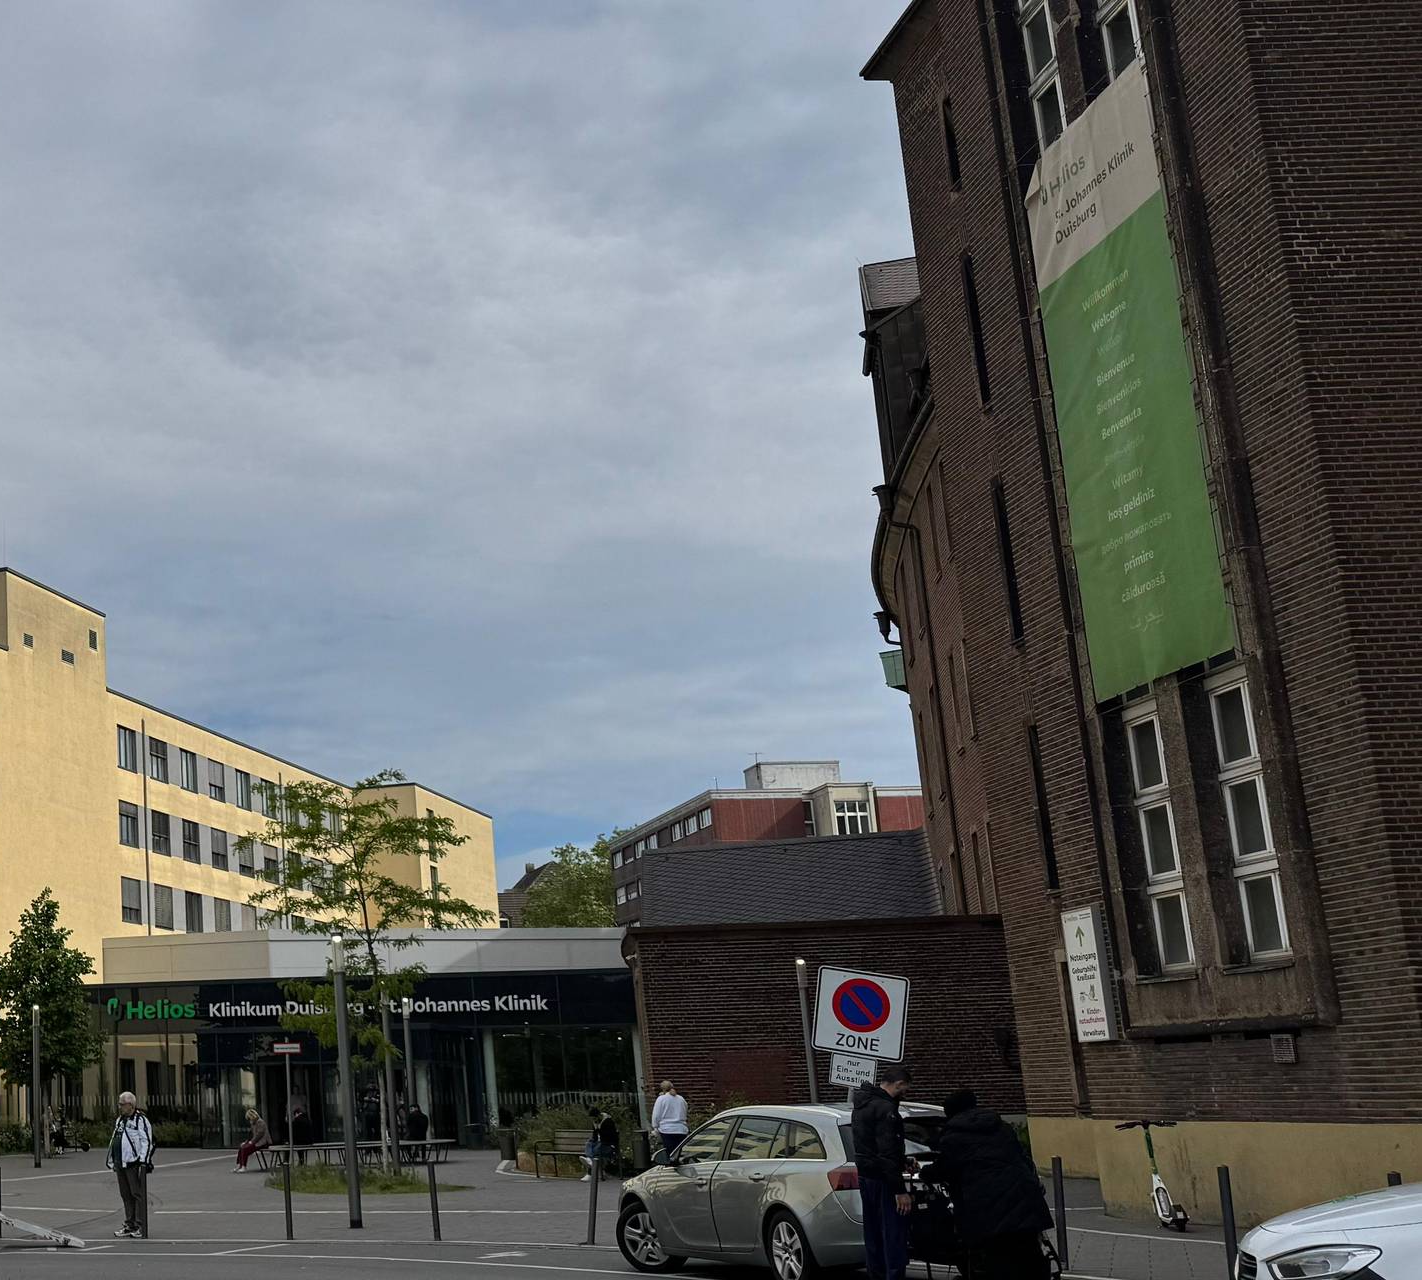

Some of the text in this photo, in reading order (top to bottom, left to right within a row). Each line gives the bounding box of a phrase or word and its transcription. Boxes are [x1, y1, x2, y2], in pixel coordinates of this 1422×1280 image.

[1049, 156, 1086, 198] Hlios
[1065, 168, 1107, 213] Johannes
[1107, 142, 1135, 174] Klinik
[1055, 203, 1097, 244] Duisburg
[1082, 269, 1128, 312] Willkommen
[1091, 301, 1127, 333] Welcome
[1096, 353, 1135, 386] Bienvenue
[1096, 377, 1142, 415] Bienvenidos
[1100, 407, 1142, 440] Benvenuta
[1111, 465, 1144, 490] Witamy
[1123, 487, 1156, 516] geldiniz
[1123, 550, 1154, 575] primire
[1070, 952, 1097, 962] Noteingang
[126, 999, 195, 1019] Helios
[209, 1001, 282, 1017] Klinikum
[405, 997, 491, 1013] Johannes
[494, 994, 549, 1011] Klinik
[835, 1033, 880, 1052] ZONE
[836, 1065, 853, 1073] Ein-
